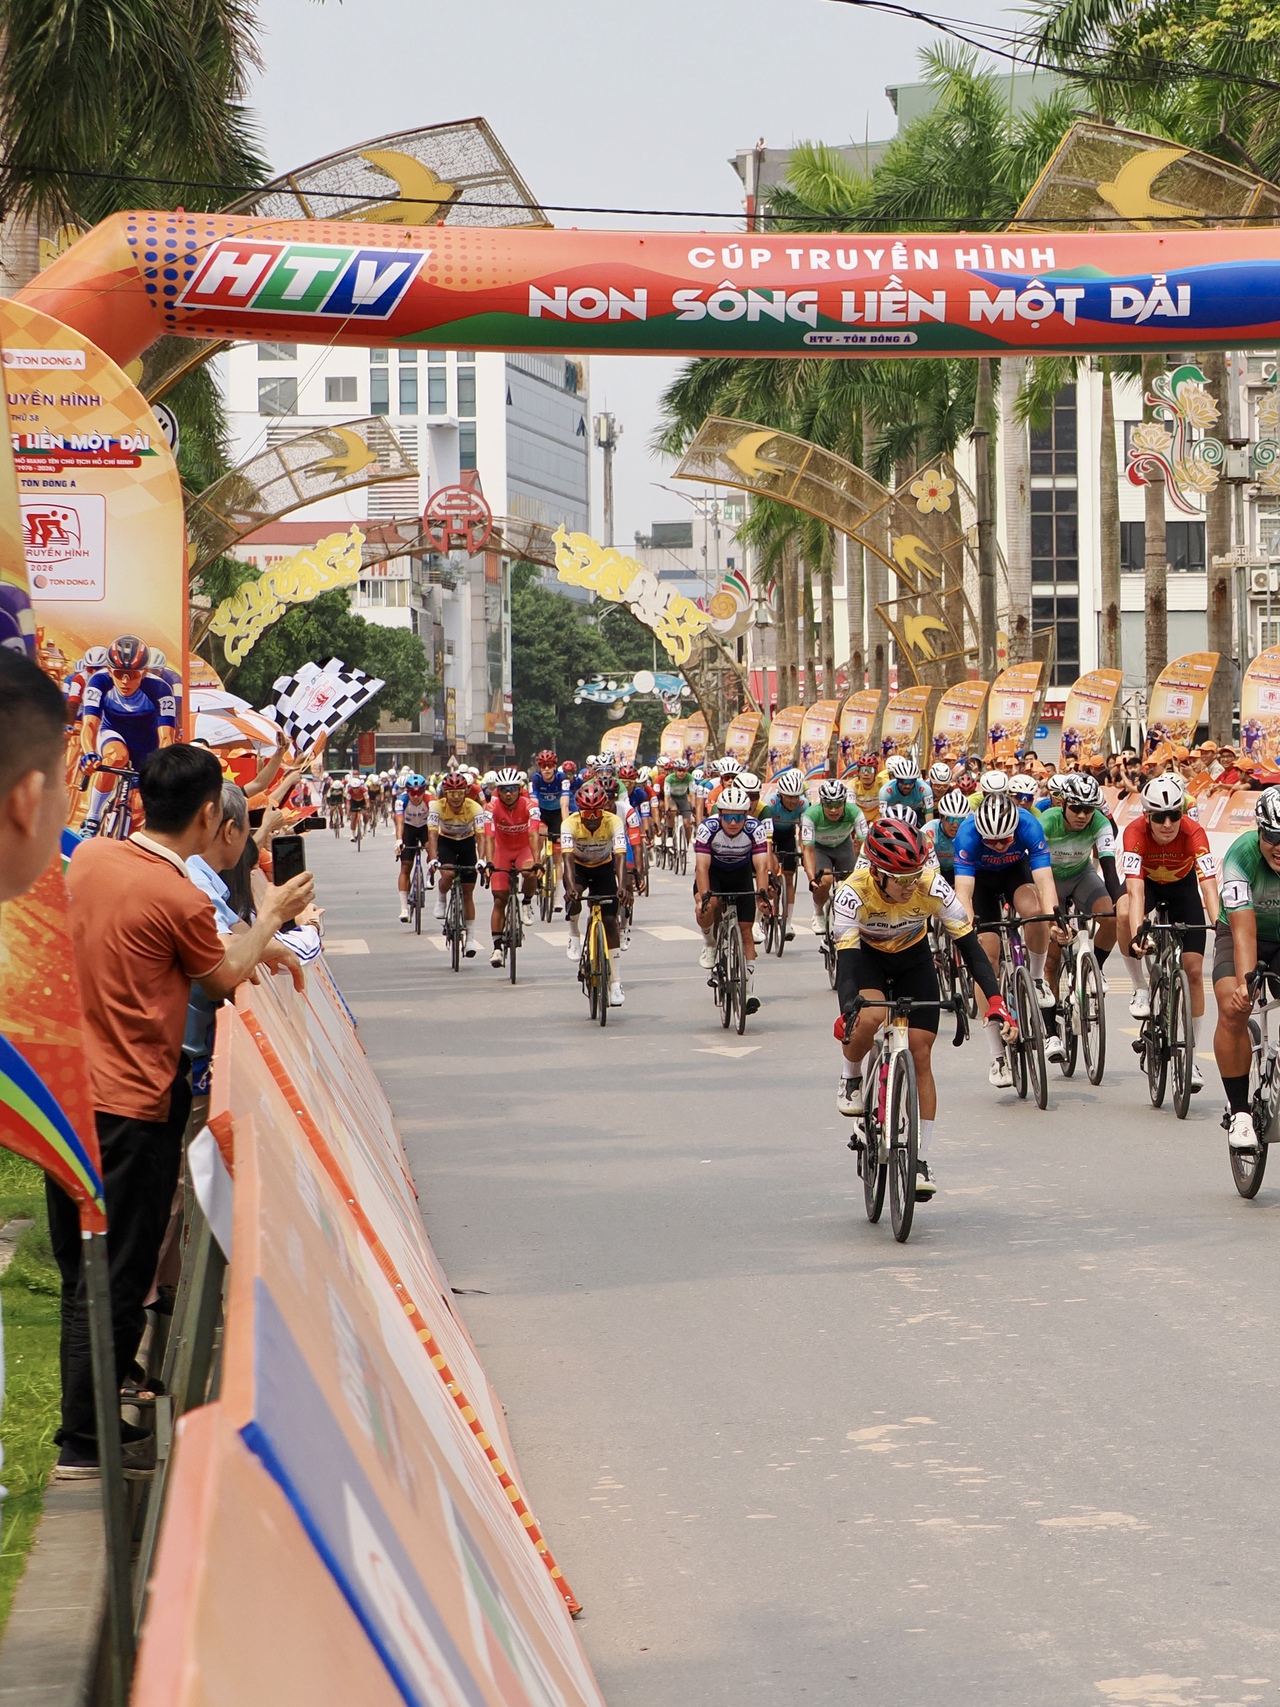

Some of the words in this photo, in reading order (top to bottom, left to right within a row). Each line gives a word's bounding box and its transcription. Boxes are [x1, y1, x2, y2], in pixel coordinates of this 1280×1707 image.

[688, 243, 772, 270] CÚP
[785, 241, 939, 270] TRUYỀN
[954, 243, 1056, 270] HÌNH
[194, 249, 412, 306] HTV
[528, 283, 648, 322] NON
[671, 278, 819, 330] SÔNG
[841, 274, 946, 324] LIỀN
[968, 278, 1085, 330] MỘT
[1109, 273, 1191, 326] DẢI
[809, 335, 833, 343] HTV
[843, 333, 867, 343] TÔN
[16, 356, 41, 365] TON
[42, 356, 72, 366] DONG
[73, 357, 83, 366] A
[61, 391, 103, 407] HÌNH
[29, 414, 39, 422] 38
[26, 426, 65, 451] LIỀN
[71, 430, 115, 455] MỘT
[120, 429, 150, 453] DẢI
[21, 477, 40, 488] TÔN
[65, 548, 90, 557] HÌNH
[30, 564, 54, 572] 2026
[50, 578, 65, 586] TON
[66, 578, 90, 586] DONG
[86, 689, 102, 701] 22
[161, 700, 175, 711] 22
[1104, 837, 1111, 847] 2
[1123, 855, 1140, 869] 127
[1231, 885, 1239, 902] 1
